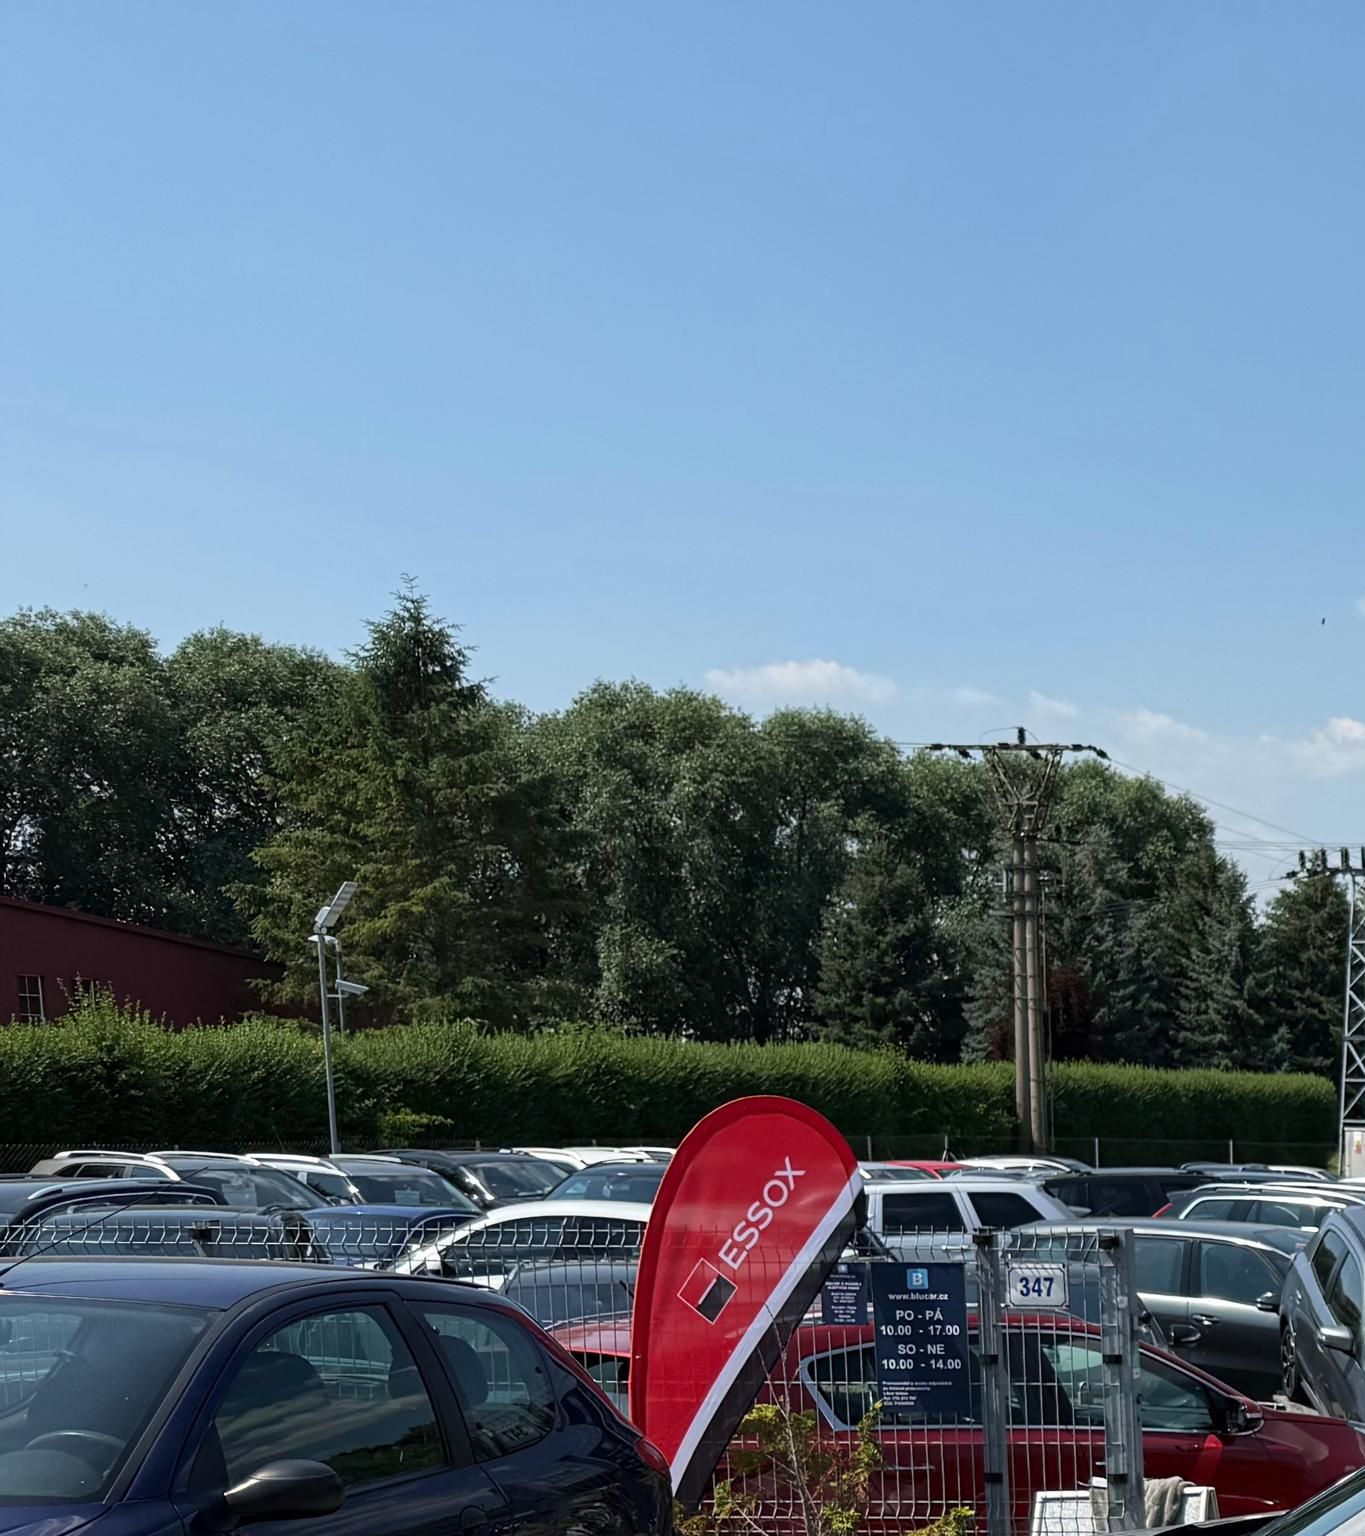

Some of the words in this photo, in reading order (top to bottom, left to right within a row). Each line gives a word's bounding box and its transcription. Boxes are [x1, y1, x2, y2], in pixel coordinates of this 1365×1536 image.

[718, 1155, 806, 1270] ESSOX
[911, 1272, 923, 1286] B
[1019, 1276, 1055, 1297] 347
[895, 1309, 915, 1321] PO
[925, 1306, 944, 1321] PÁ
[880, 1324, 912, 1336] 10.00
[928, 1324, 960, 1336] 17.00
[897, 1343, 917, 1355] SO
[927, 1343, 946, 1355] NE
[881, 1358, 914, 1370] 10.00
[929, 1358, 962, 1370] 14.00
